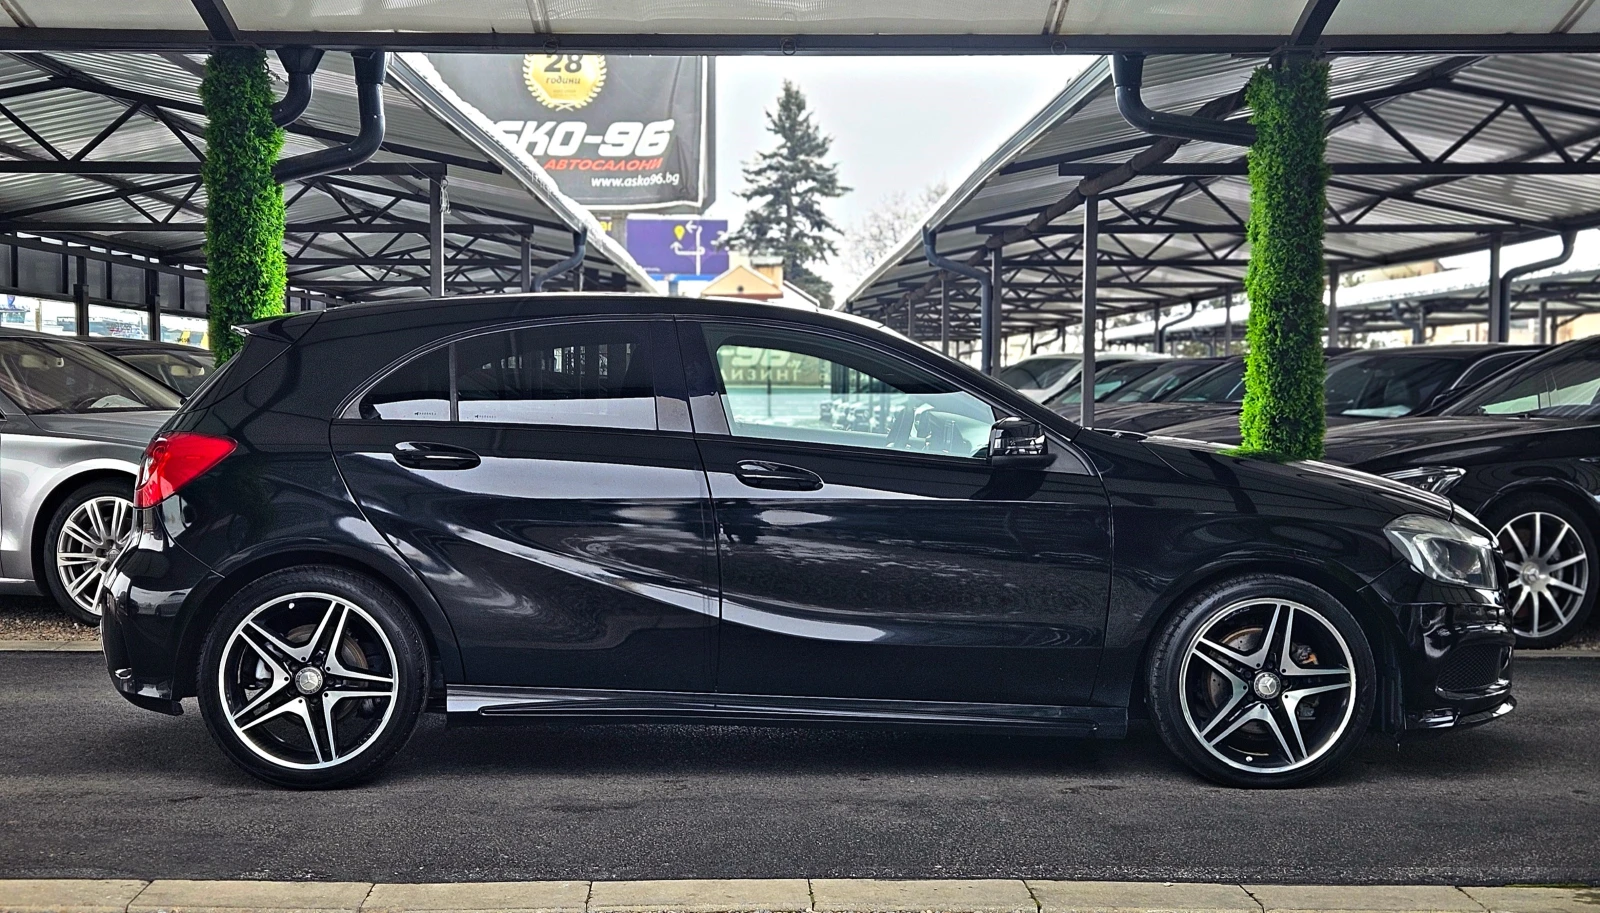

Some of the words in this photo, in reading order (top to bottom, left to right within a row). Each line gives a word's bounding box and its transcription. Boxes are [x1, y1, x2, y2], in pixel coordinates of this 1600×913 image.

[544, 54, 583, 73] 28
[545, 76, 581, 85] години
[494, 119, 675, 157] SKO-96
[544, 158, 663, 172] АВТОСАЛОНИ
[591, 172, 680, 187] www.asko96.bg
